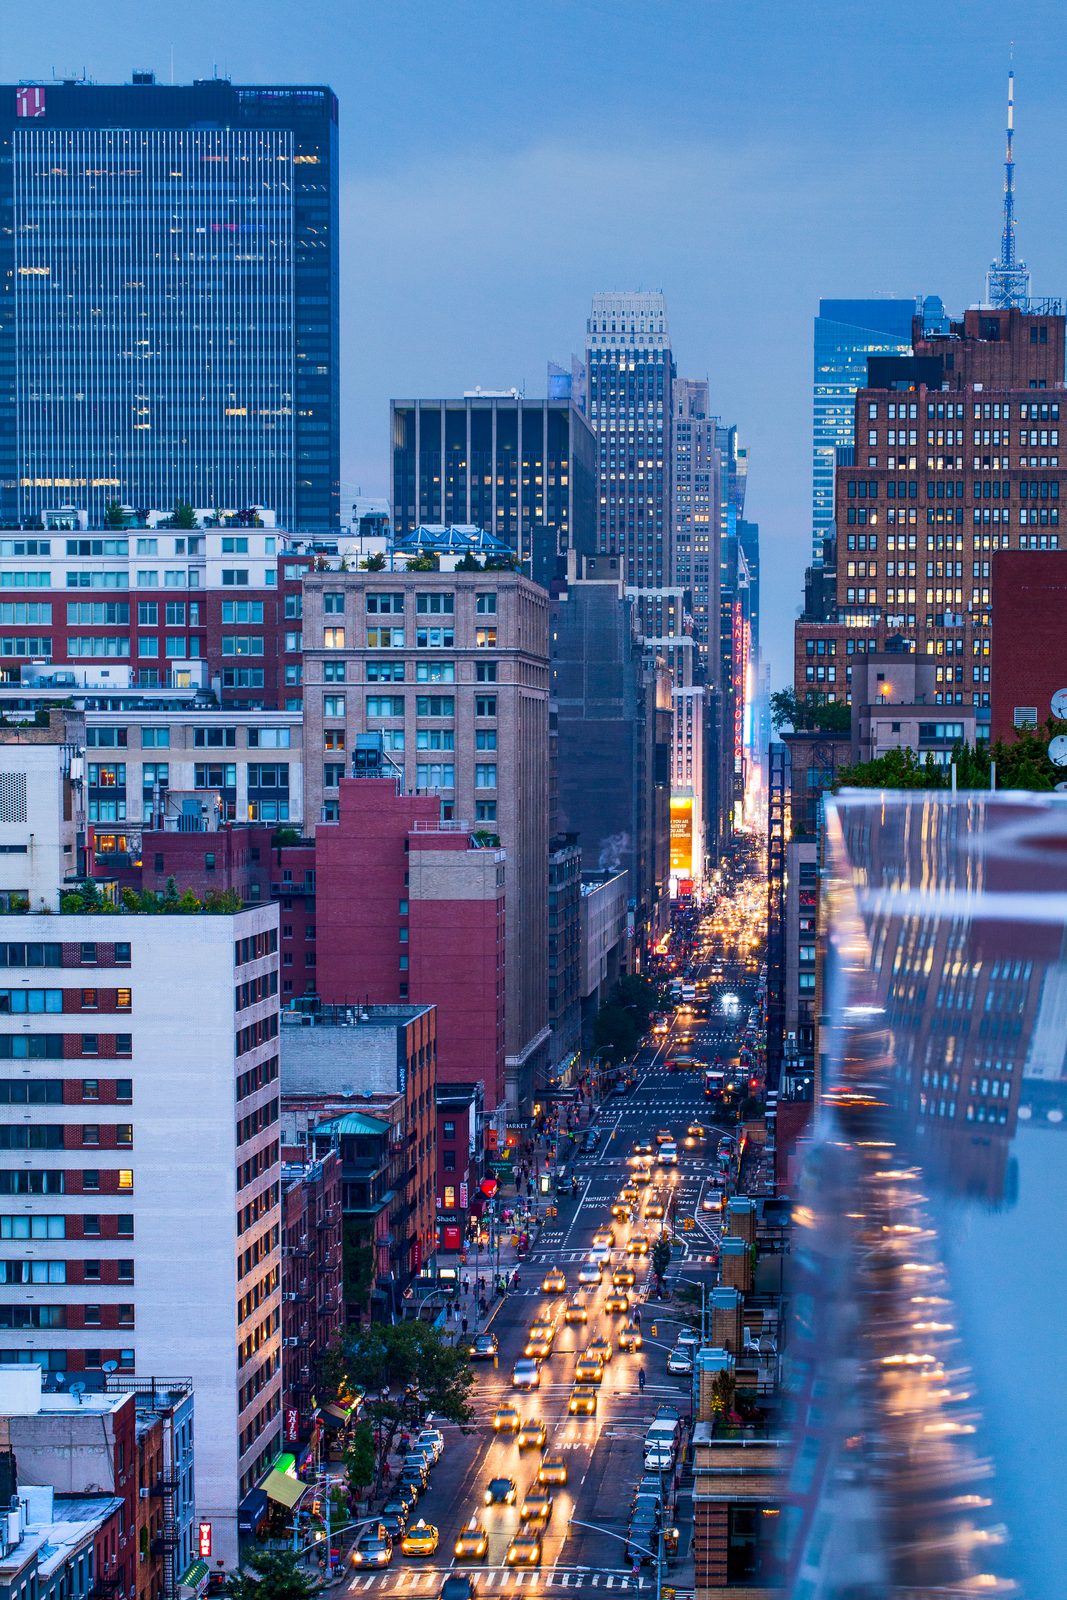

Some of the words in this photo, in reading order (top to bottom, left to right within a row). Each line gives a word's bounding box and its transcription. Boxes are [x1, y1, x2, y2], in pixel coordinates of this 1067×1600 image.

[734, 675, 742, 685] &
[734, 697, 742, 758] YOUNG
[288, 1410, 298, 1441] NAILS
[554, 1442, 591, 1450] LANE
[200, 1524, 211, 1555] WINE
